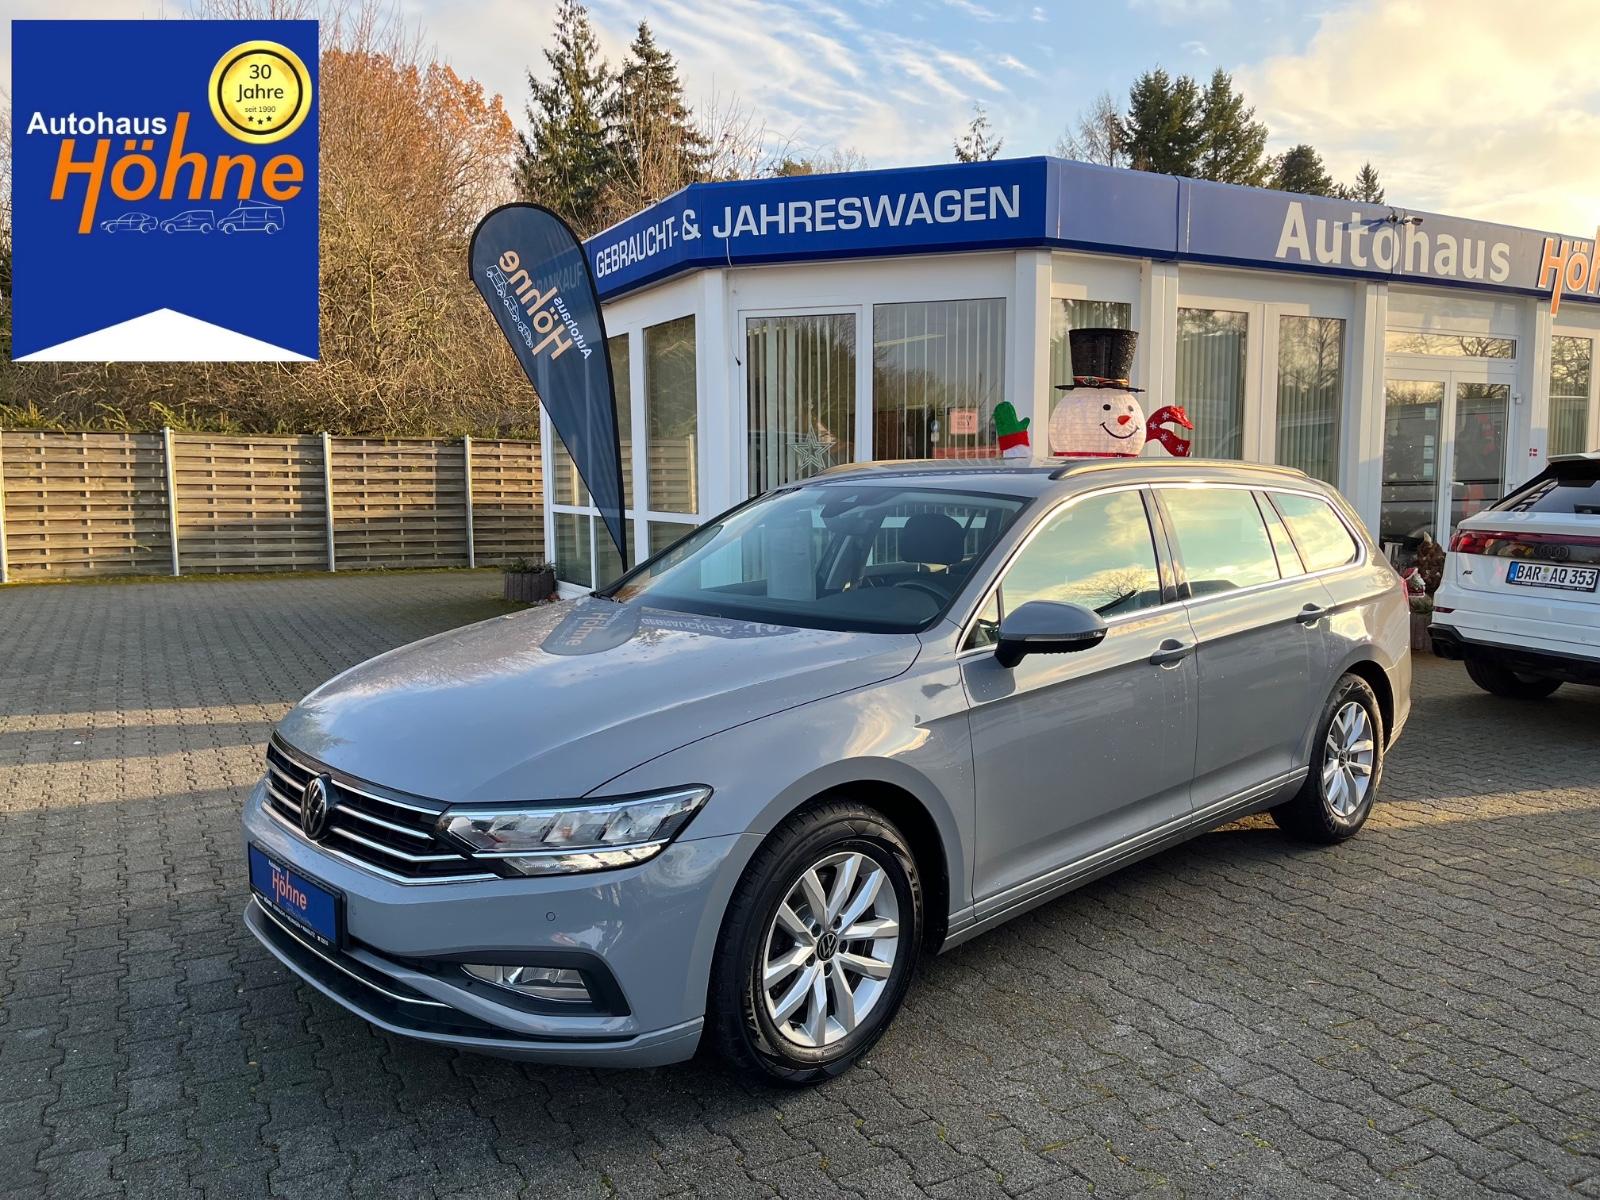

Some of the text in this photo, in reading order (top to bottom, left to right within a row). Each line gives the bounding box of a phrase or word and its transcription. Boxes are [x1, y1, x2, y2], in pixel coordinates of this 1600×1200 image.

[596, 184, 1020, 278] GEBRAUCHT- & JAHRESWAGEN
[1275, 201, 1510, 283] Autohaus
[1516, 564, 1542, 581] BAR
[1549, 567, 1568, 584] AQ
[1569, 569, 1596, 586] 353
[272, 868, 307, 911] Höhne
